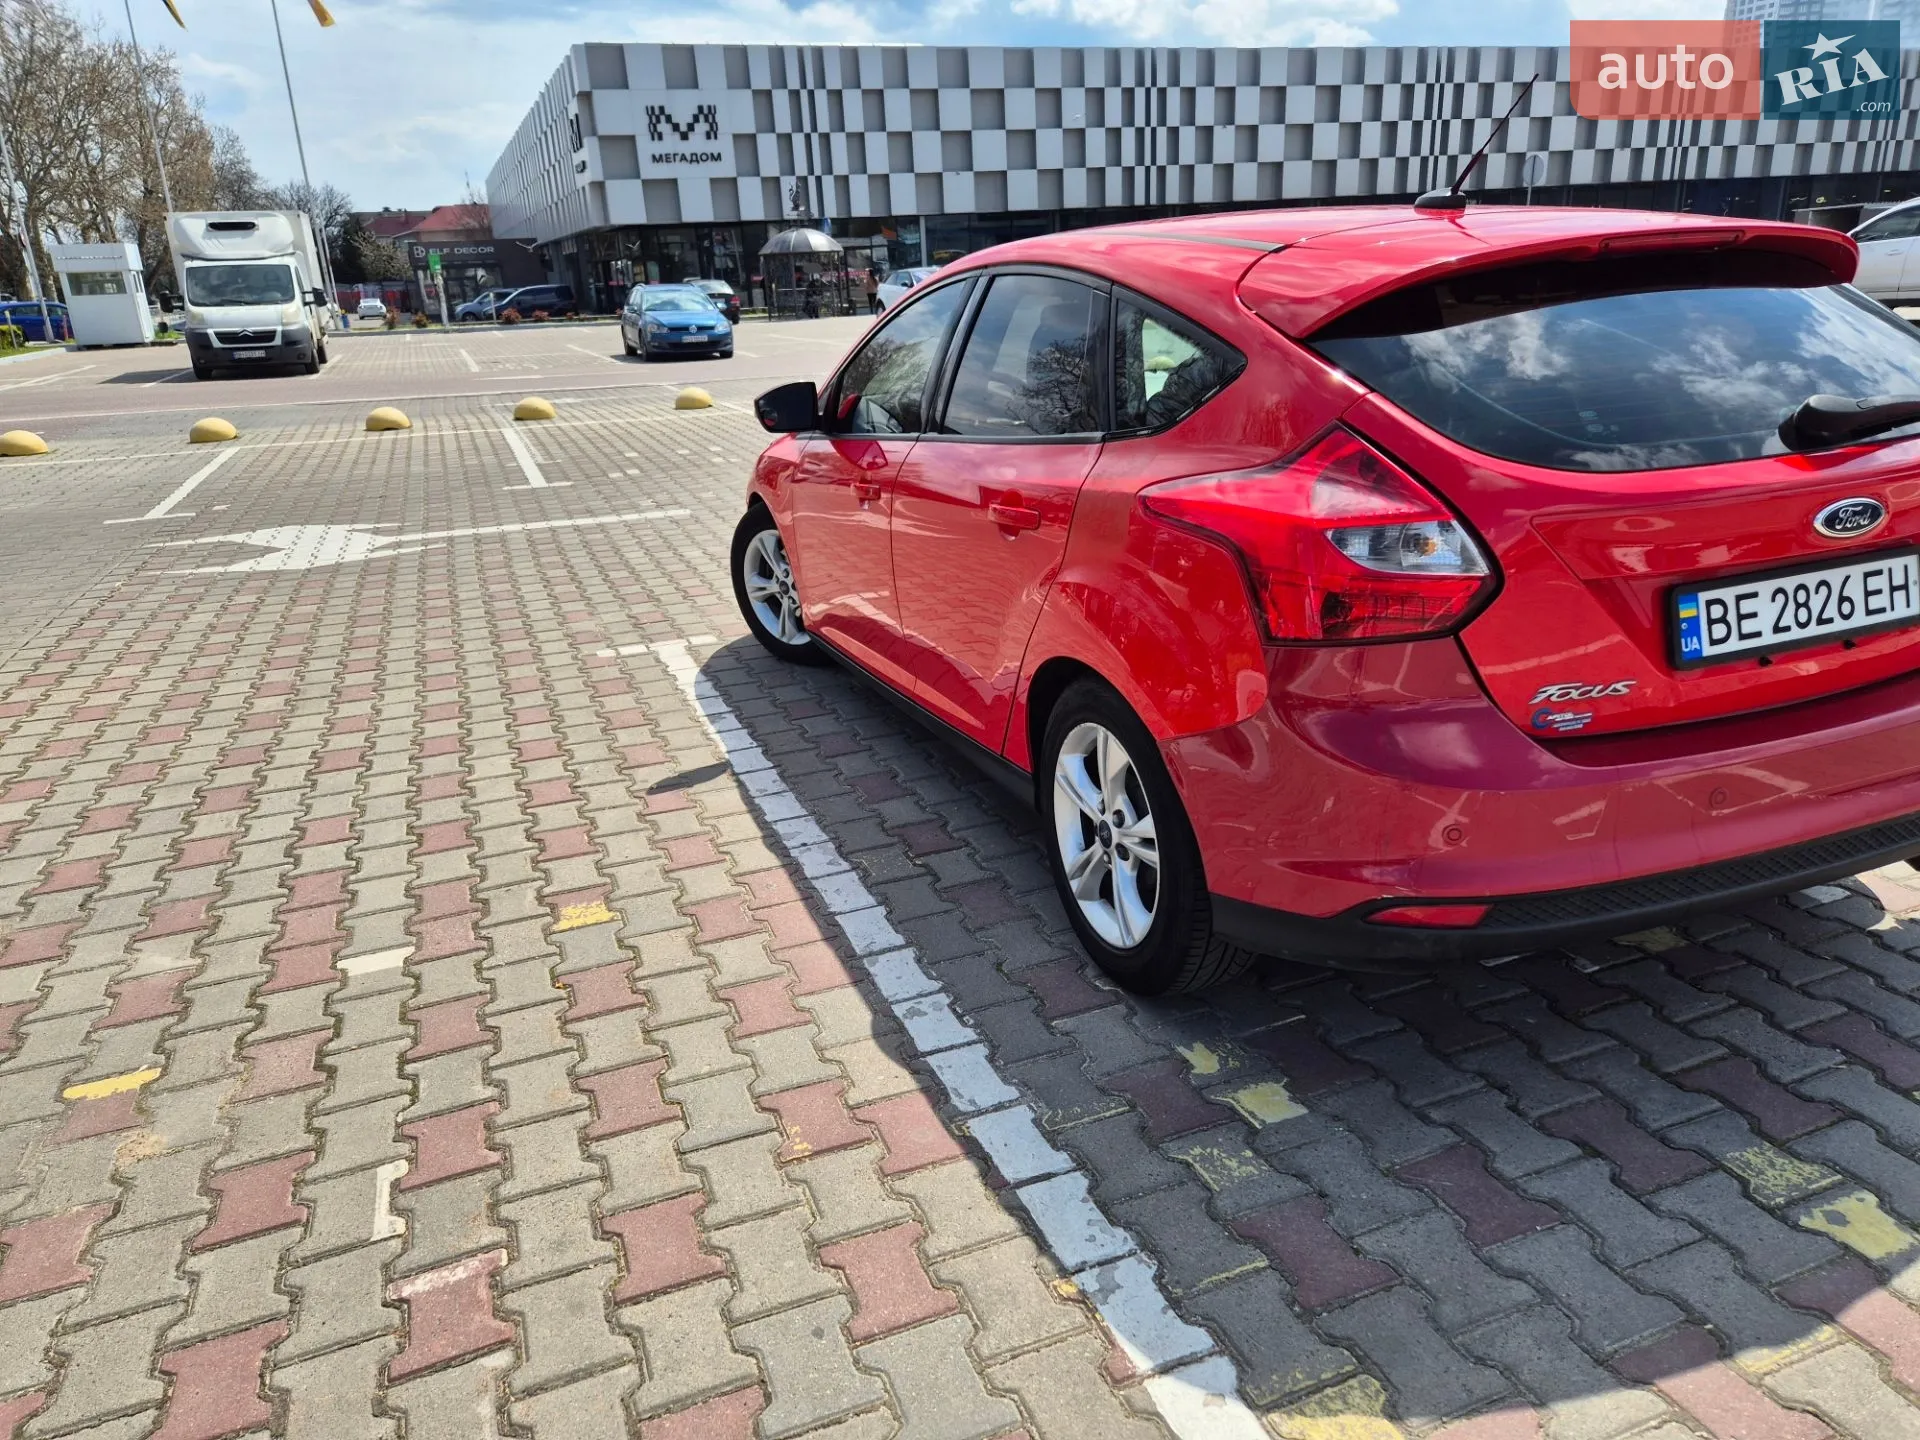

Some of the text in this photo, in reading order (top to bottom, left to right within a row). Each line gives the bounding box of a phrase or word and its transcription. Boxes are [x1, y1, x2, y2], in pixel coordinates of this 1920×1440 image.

[651, 152, 722, 165] МЕГАДОМ
[454, 246, 495, 254] DECOR
[1835, 505, 1872, 530] Ford
[1705, 564, 1911, 646] BE 2826 EH
[1681, 637, 1700, 653] UA
